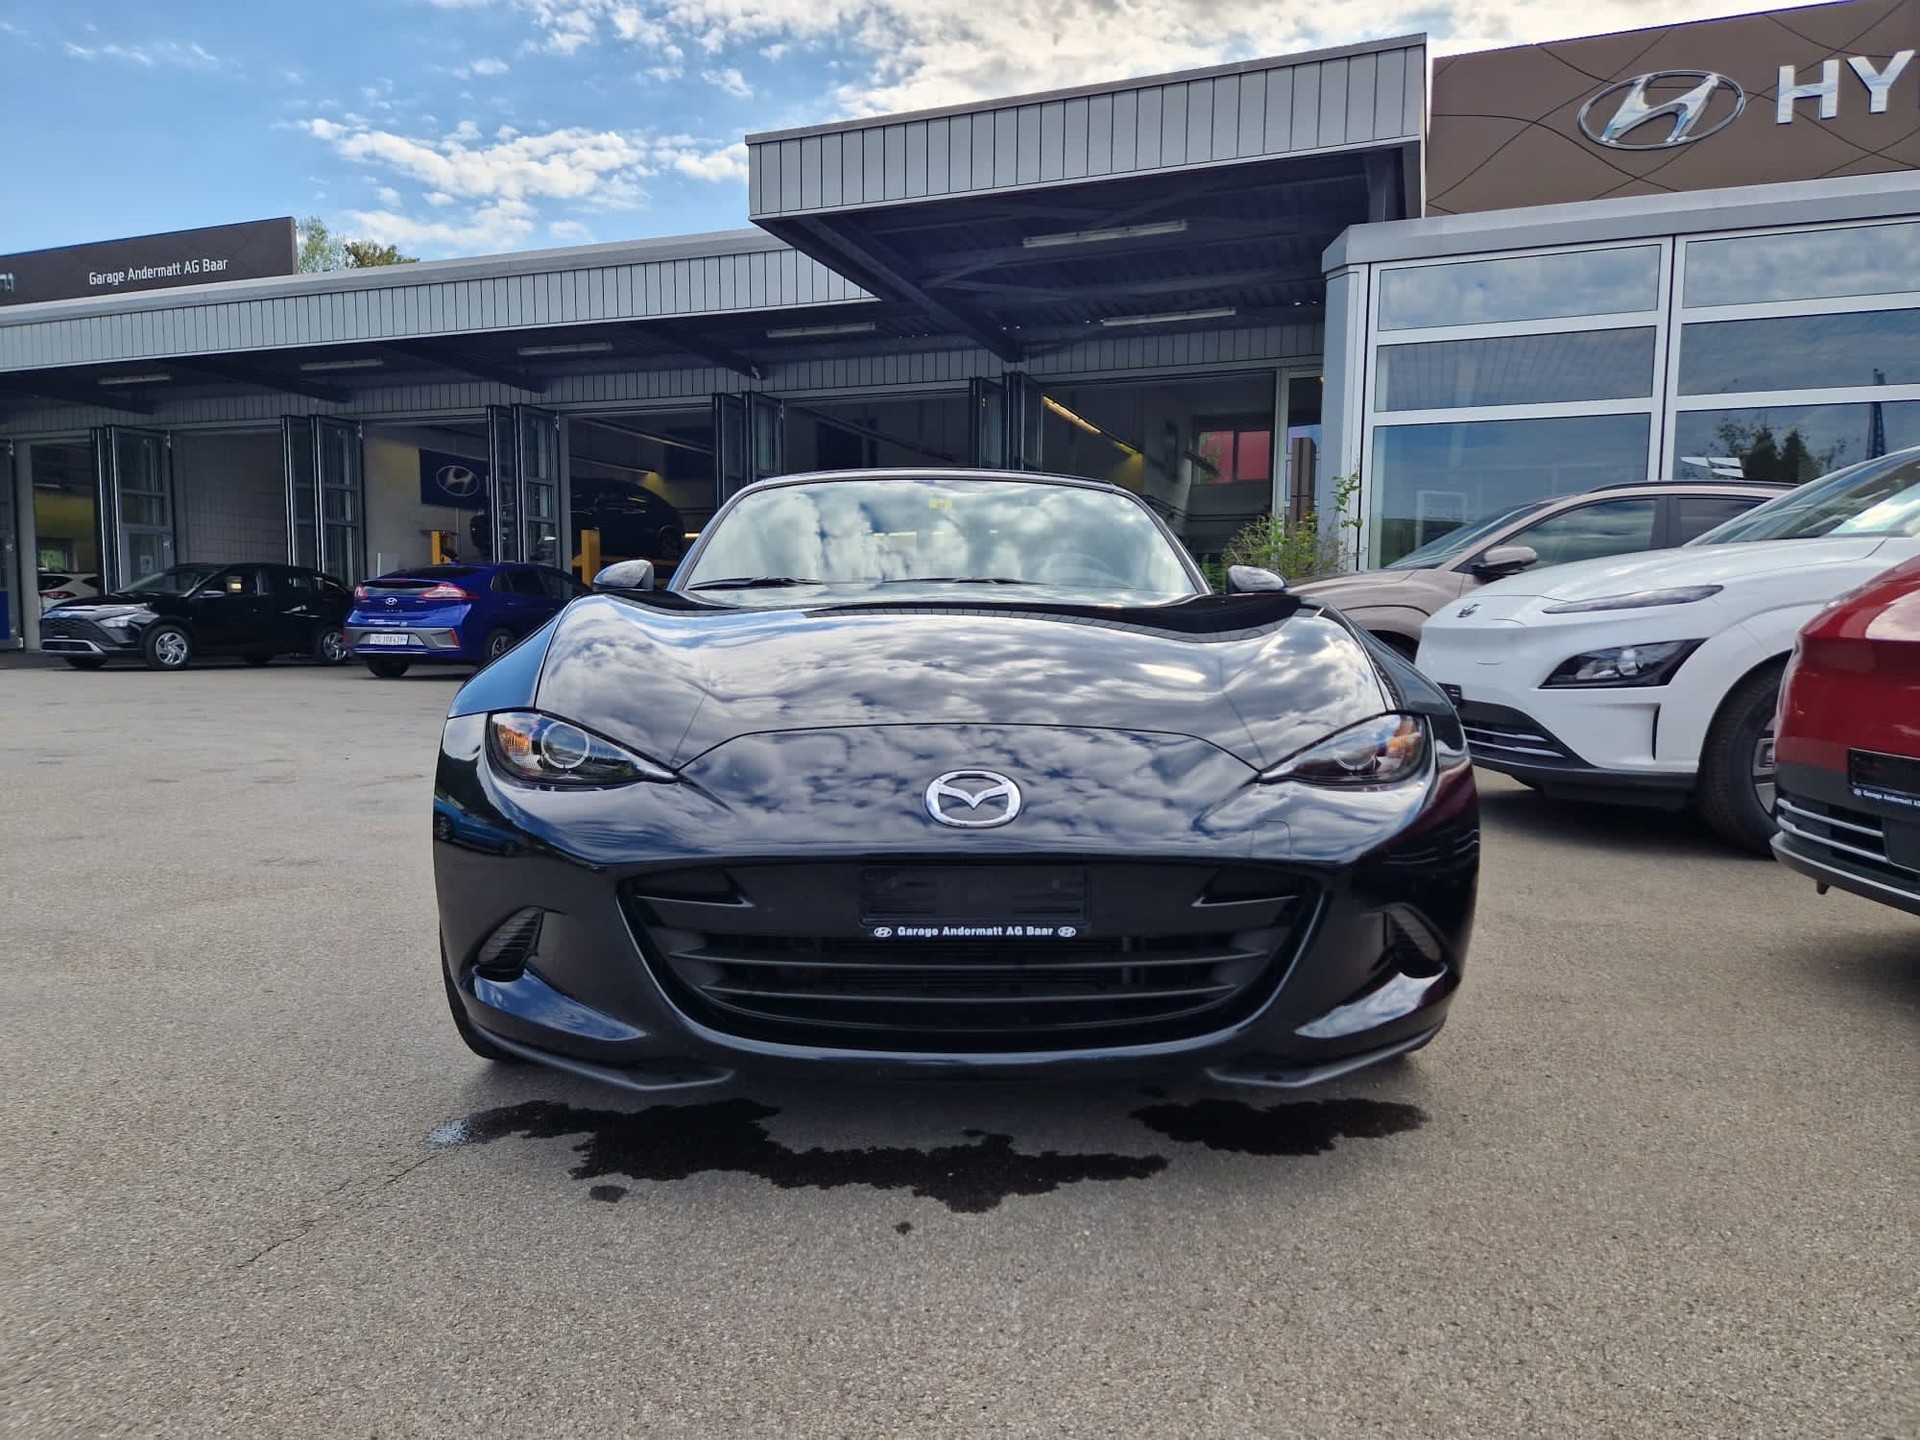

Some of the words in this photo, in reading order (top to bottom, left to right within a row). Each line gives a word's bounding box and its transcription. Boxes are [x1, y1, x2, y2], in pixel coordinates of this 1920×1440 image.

[89, 270, 124, 286] Garage
[127, 263, 181, 279] Andermatt
[184, 260, 199, 274] AG
[202, 258, 228, 272] Baar
[898, 926, 938, 937] Garage
[942, 926, 1002, 936] Andermatt
[1006, 926, 1022, 936] AG
[1026, 926, 1053, 936] Baar
